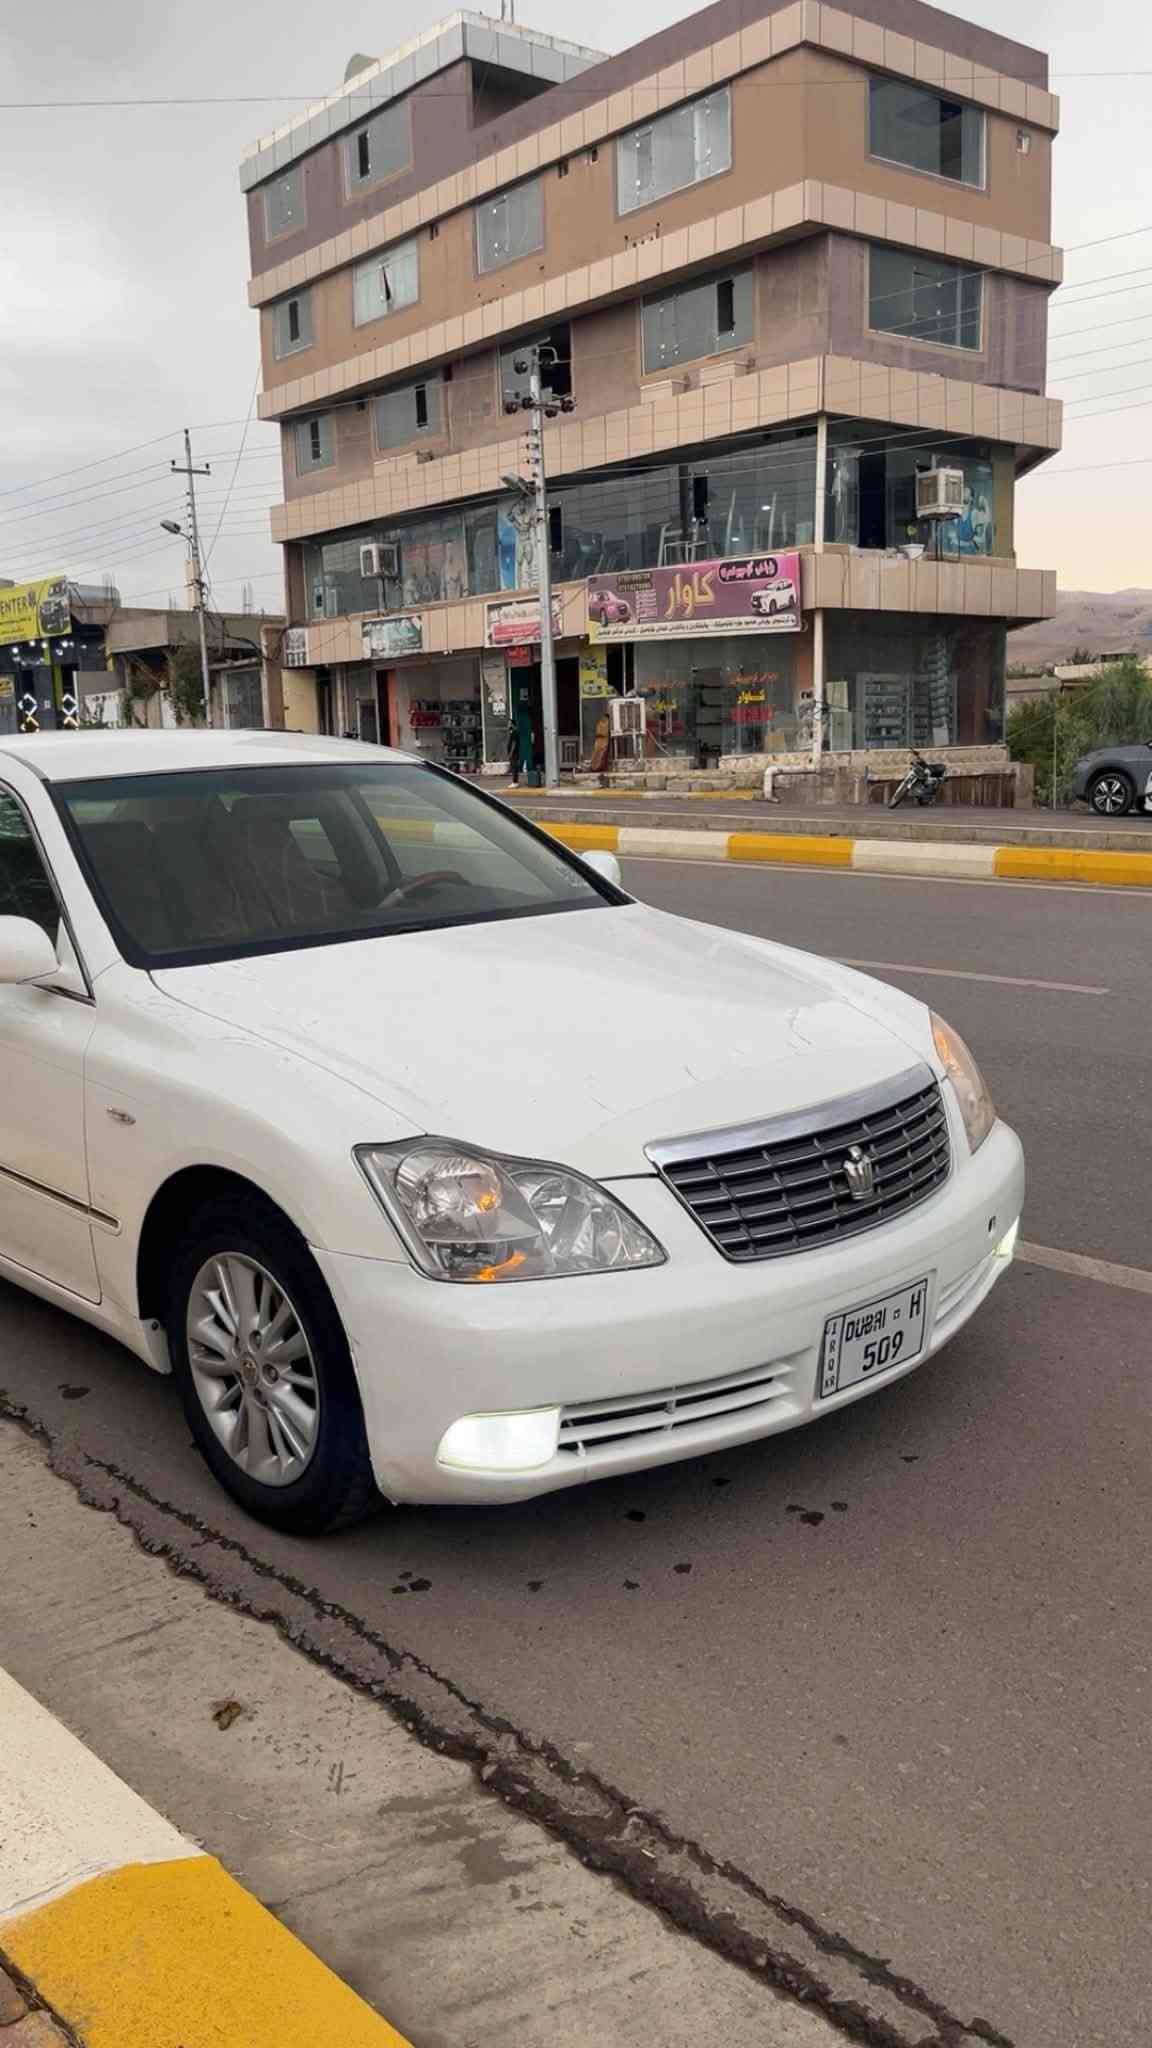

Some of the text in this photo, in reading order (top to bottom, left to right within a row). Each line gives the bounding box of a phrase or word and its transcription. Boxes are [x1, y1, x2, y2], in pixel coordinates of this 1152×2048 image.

[845, 1289, 920, 1342] DUBAI H
[862, 1330, 904, 1371] 509
